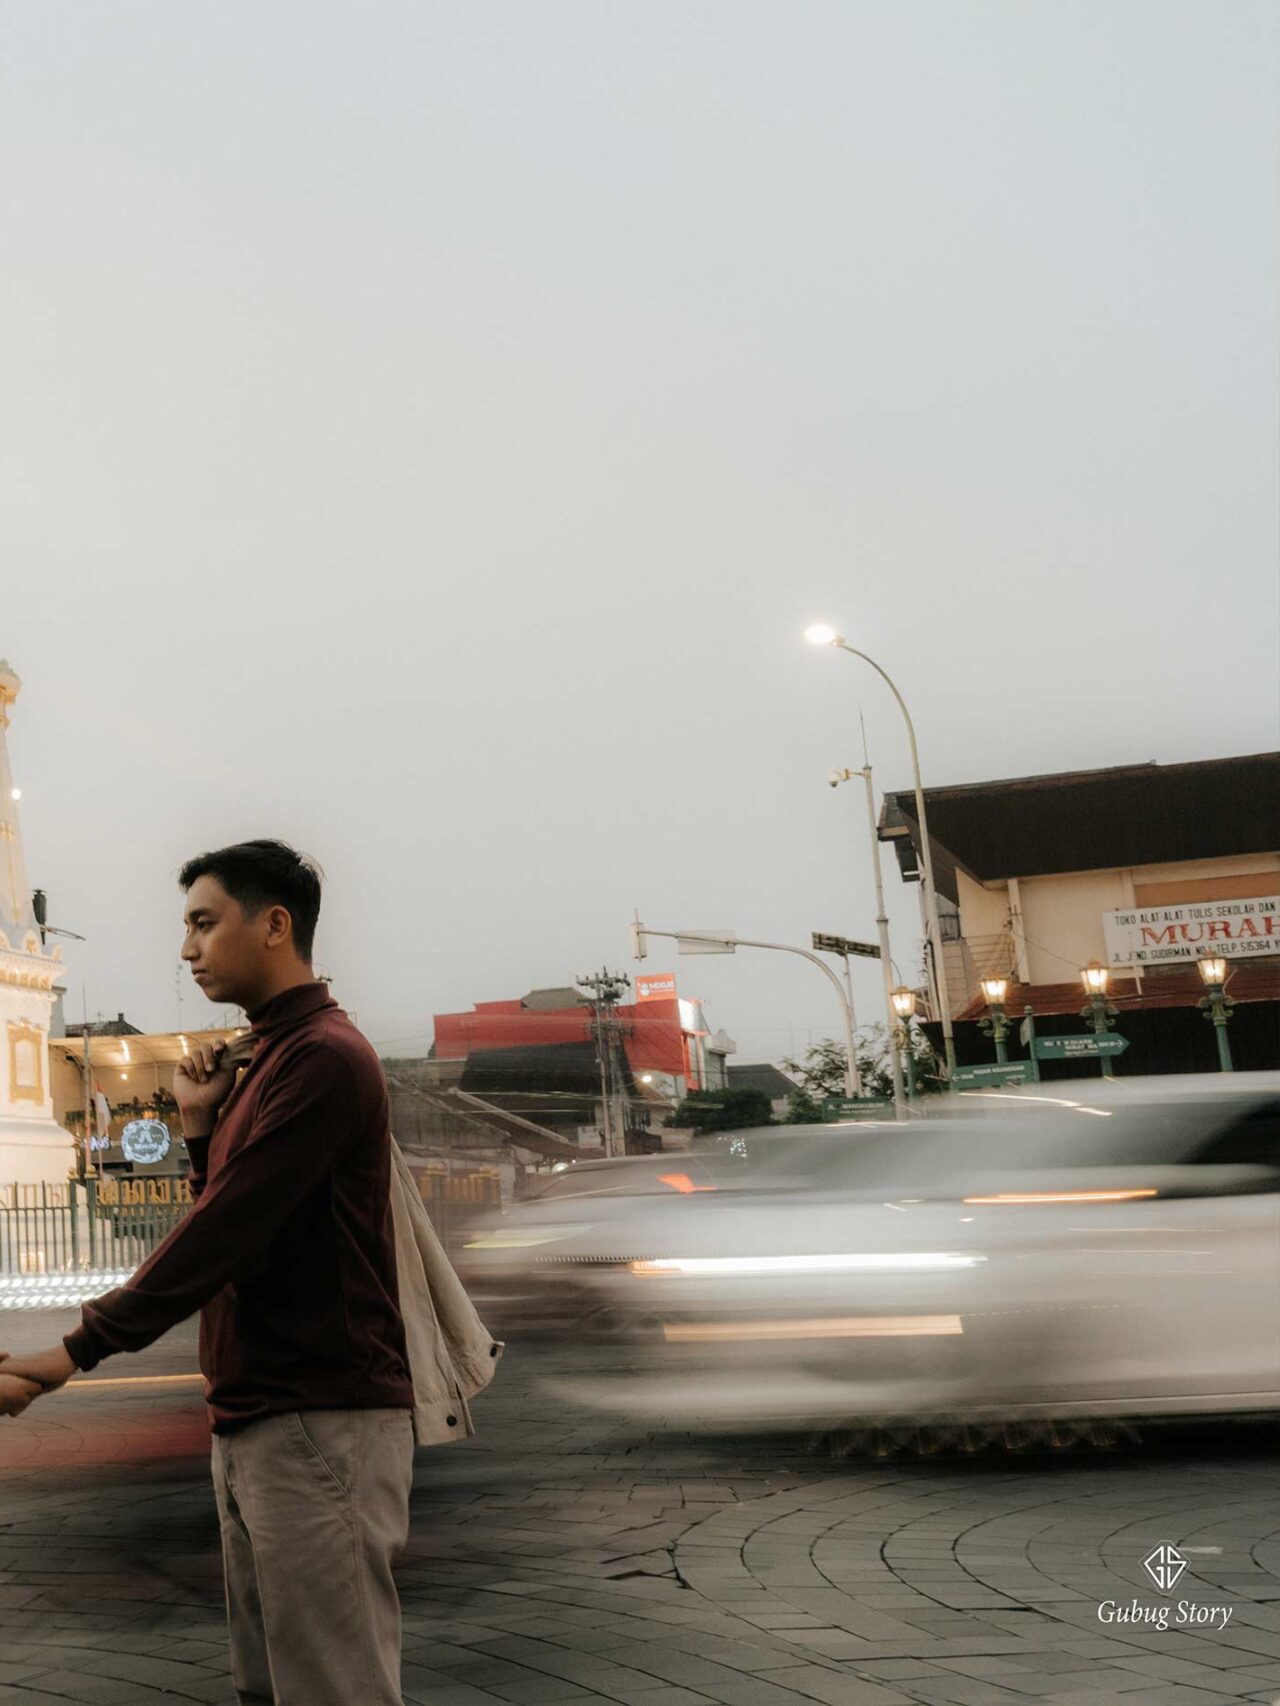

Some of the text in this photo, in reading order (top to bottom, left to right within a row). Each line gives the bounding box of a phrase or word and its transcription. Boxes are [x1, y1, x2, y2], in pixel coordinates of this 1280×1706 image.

[1115, 914, 1137, 926] TOKO
[1188, 907, 1213, 919] TULIS
[1216, 903, 1255, 917] SEKOLAH
[1258, 901, 1276, 913] DAN
[1151, 947, 1191, 960] SUDIRMAN
